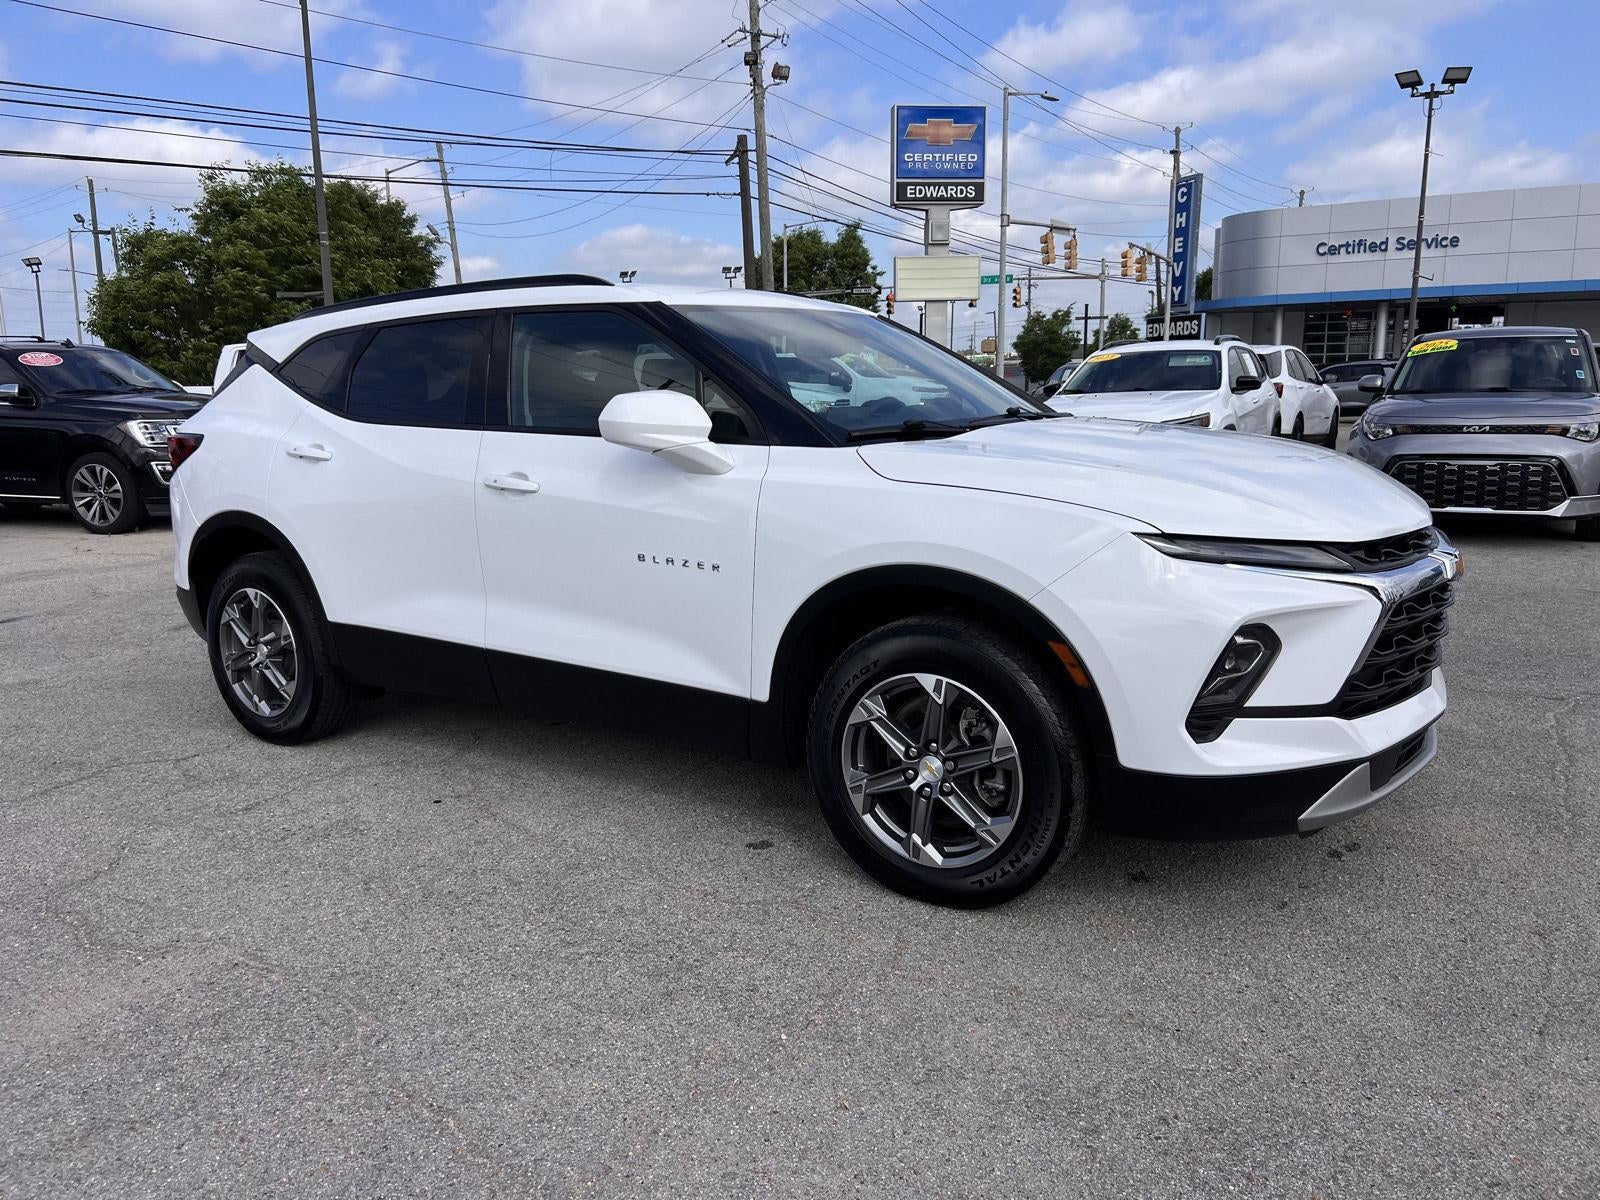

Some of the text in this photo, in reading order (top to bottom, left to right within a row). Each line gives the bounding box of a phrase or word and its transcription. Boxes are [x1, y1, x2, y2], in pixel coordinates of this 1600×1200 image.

[904, 153, 978, 162] CERTIFIED
[908, 162, 974, 170] PRE-OWNED
[906, 185, 976, 198] EDWARDS
[1171, 186, 1188, 302] CHEVY
[1315, 237, 1389, 257] Certified
[637, 552, 721, 573] BLAZER
[826, 659, 880, 725] CONTACT
